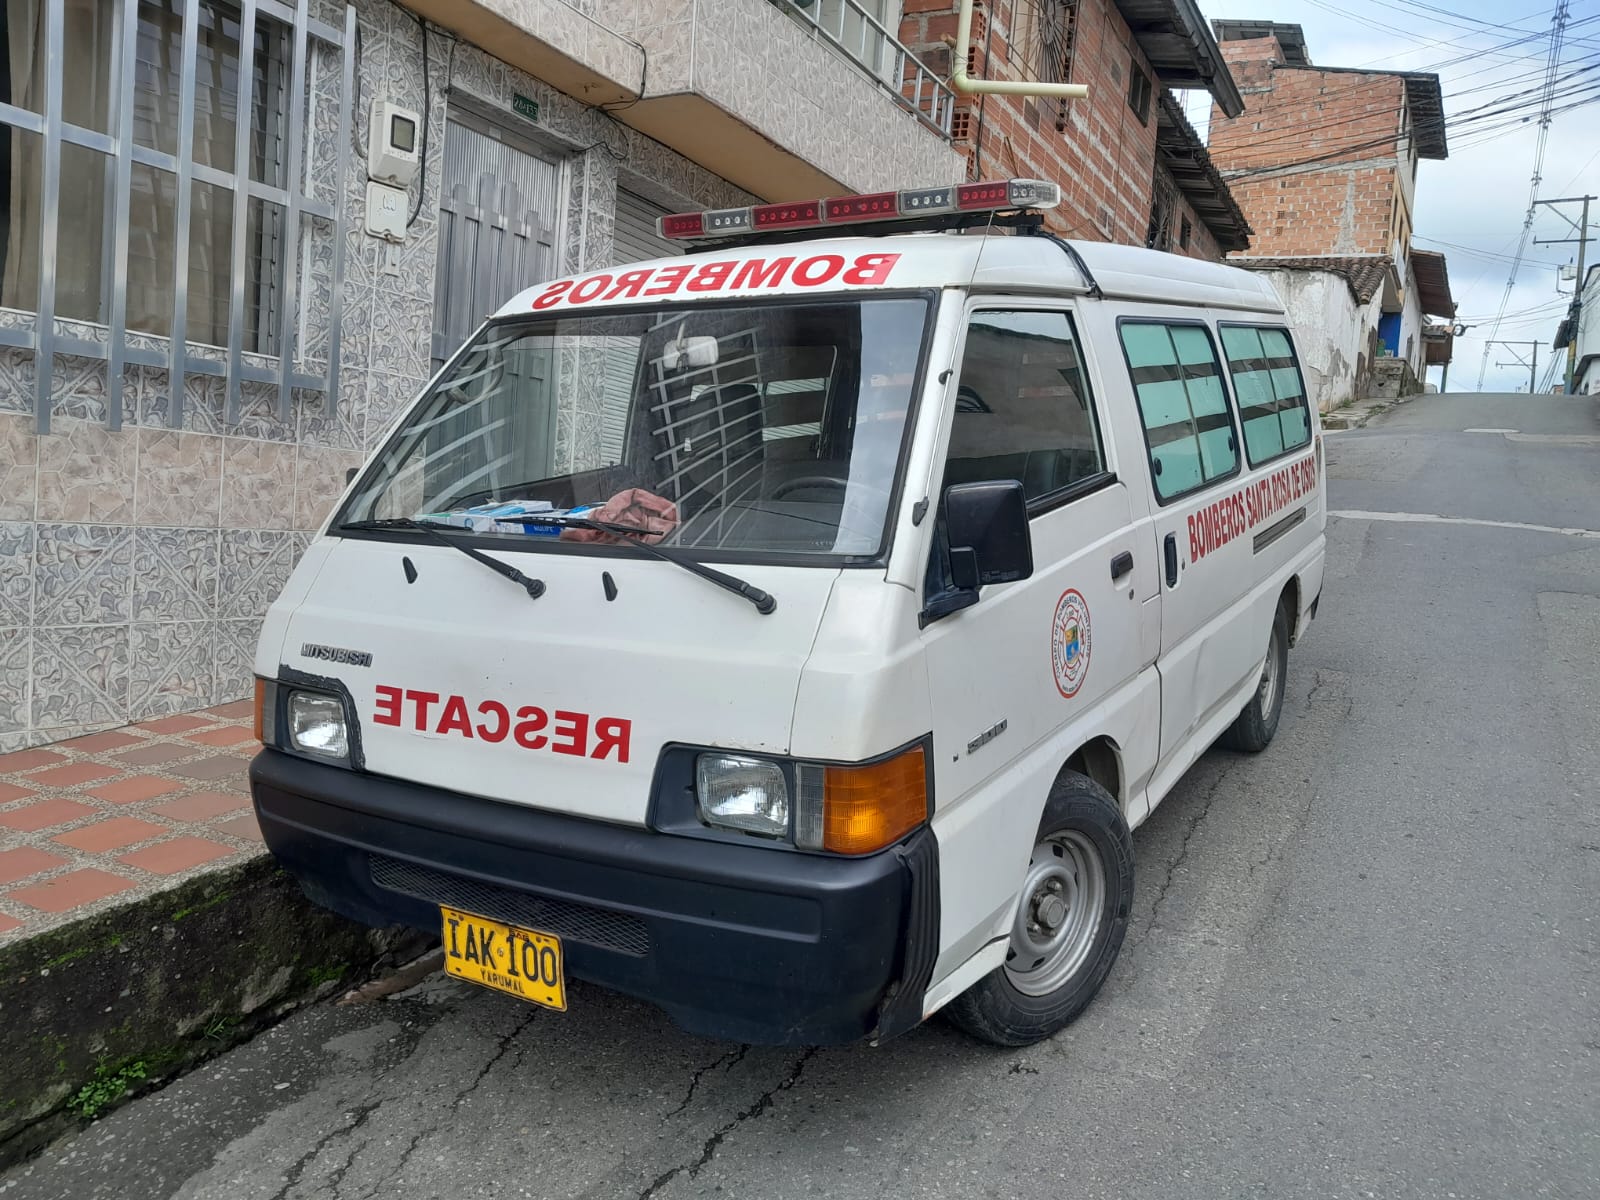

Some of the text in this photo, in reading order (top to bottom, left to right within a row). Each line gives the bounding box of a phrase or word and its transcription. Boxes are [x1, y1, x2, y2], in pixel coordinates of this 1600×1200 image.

[1187, 455, 1315, 563] BOMBEROS SANTA ROSA DE OSOS
[300, 642, 374, 668] MITSUBISHI
[447, 918, 558, 988] IAK 100
[480, 968, 525, 994] YARUMAL
